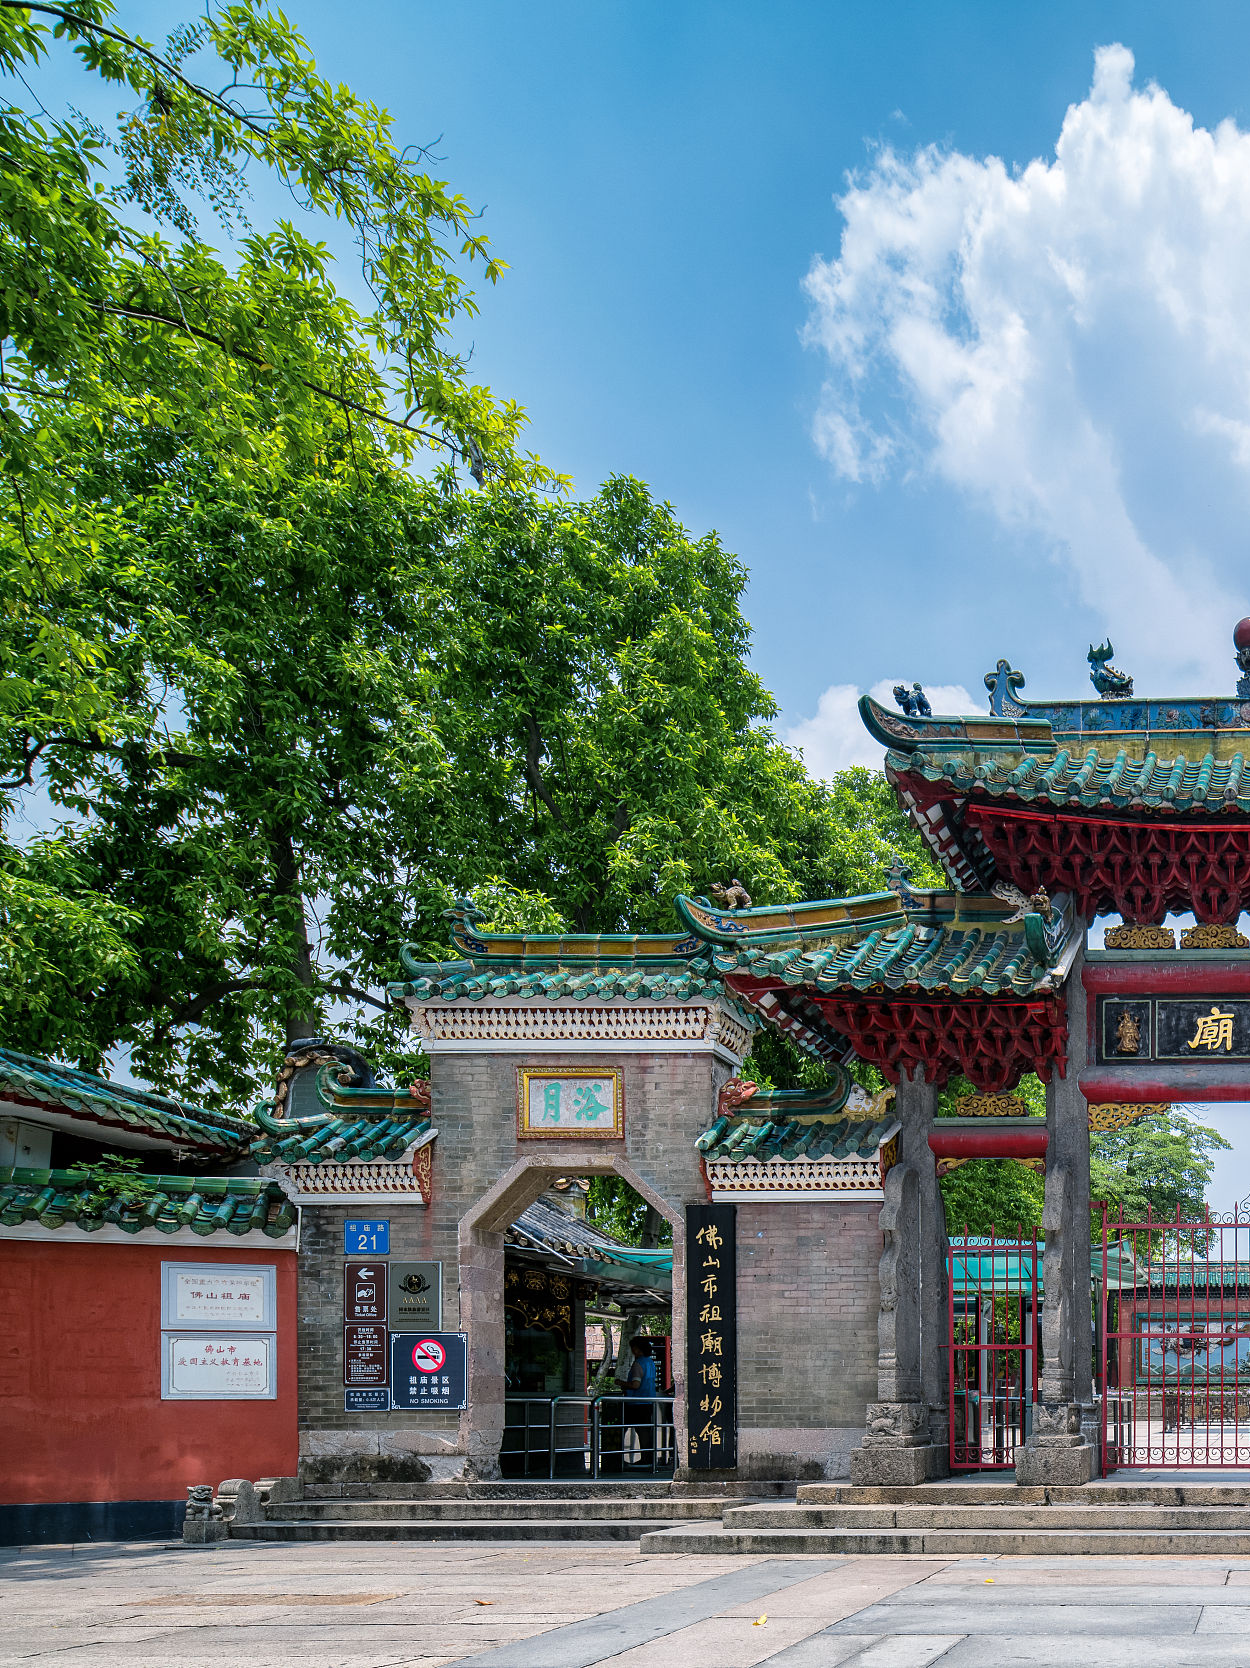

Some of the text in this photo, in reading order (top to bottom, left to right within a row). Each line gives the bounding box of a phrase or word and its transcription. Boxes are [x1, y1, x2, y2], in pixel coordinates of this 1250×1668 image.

[349, 1224, 385, 1232] 祖庙路
[357, 1234, 377, 1250] 21
[189, 1291, 251, 1301] 佛山祖庙
[354, 1305, 378, 1313] 售票处
[204, 1343, 237, 1355] 佛山市
[177, 1357, 263, 1367] 爱国主义教育基地
[408, 1375, 450, 1385] 祖庙景区
[409, 1386, 450, 1395] 禁止吸烟
